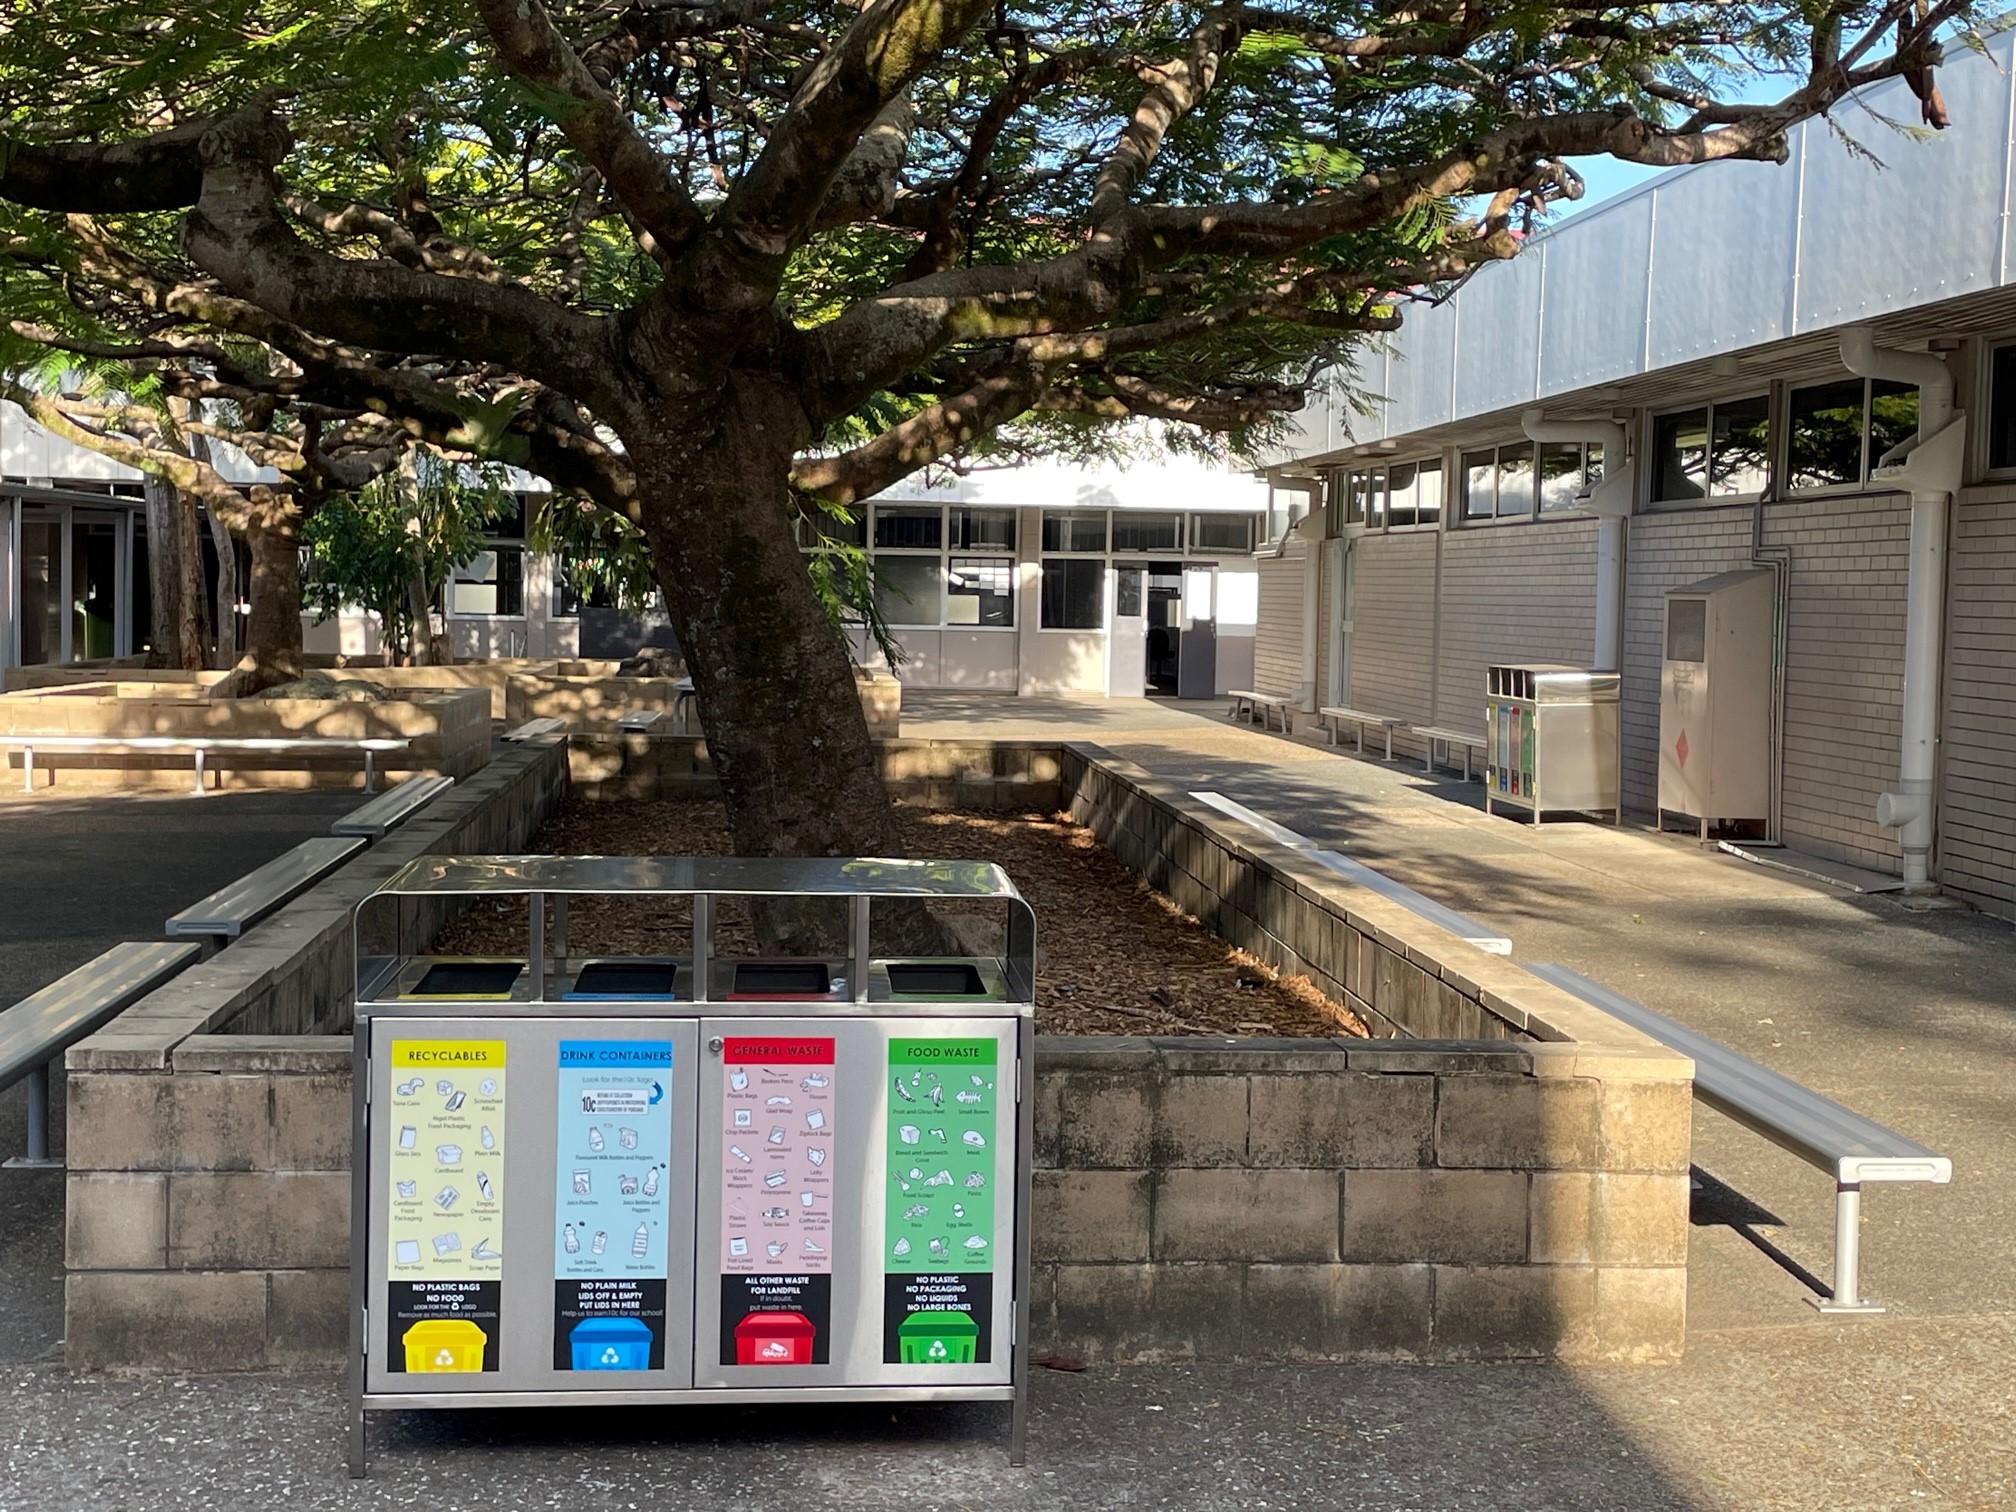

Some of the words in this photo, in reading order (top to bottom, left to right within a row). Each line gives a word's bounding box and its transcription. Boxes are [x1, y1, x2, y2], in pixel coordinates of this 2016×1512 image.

[733, 1046, 785, 1055] GENERAL
[787, 1046, 823, 1055] WASTE
[908, 1048, 941, 1057] FOOD
[944, 1048, 980, 1057] WASTE
[409, 1051, 487, 1060] RECYCLABLES
[561, 1051, 595, 1060] DRINK
[599, 1051, 672, 1060] CONTAINERS
[582, 1096, 596, 1112] 10c
